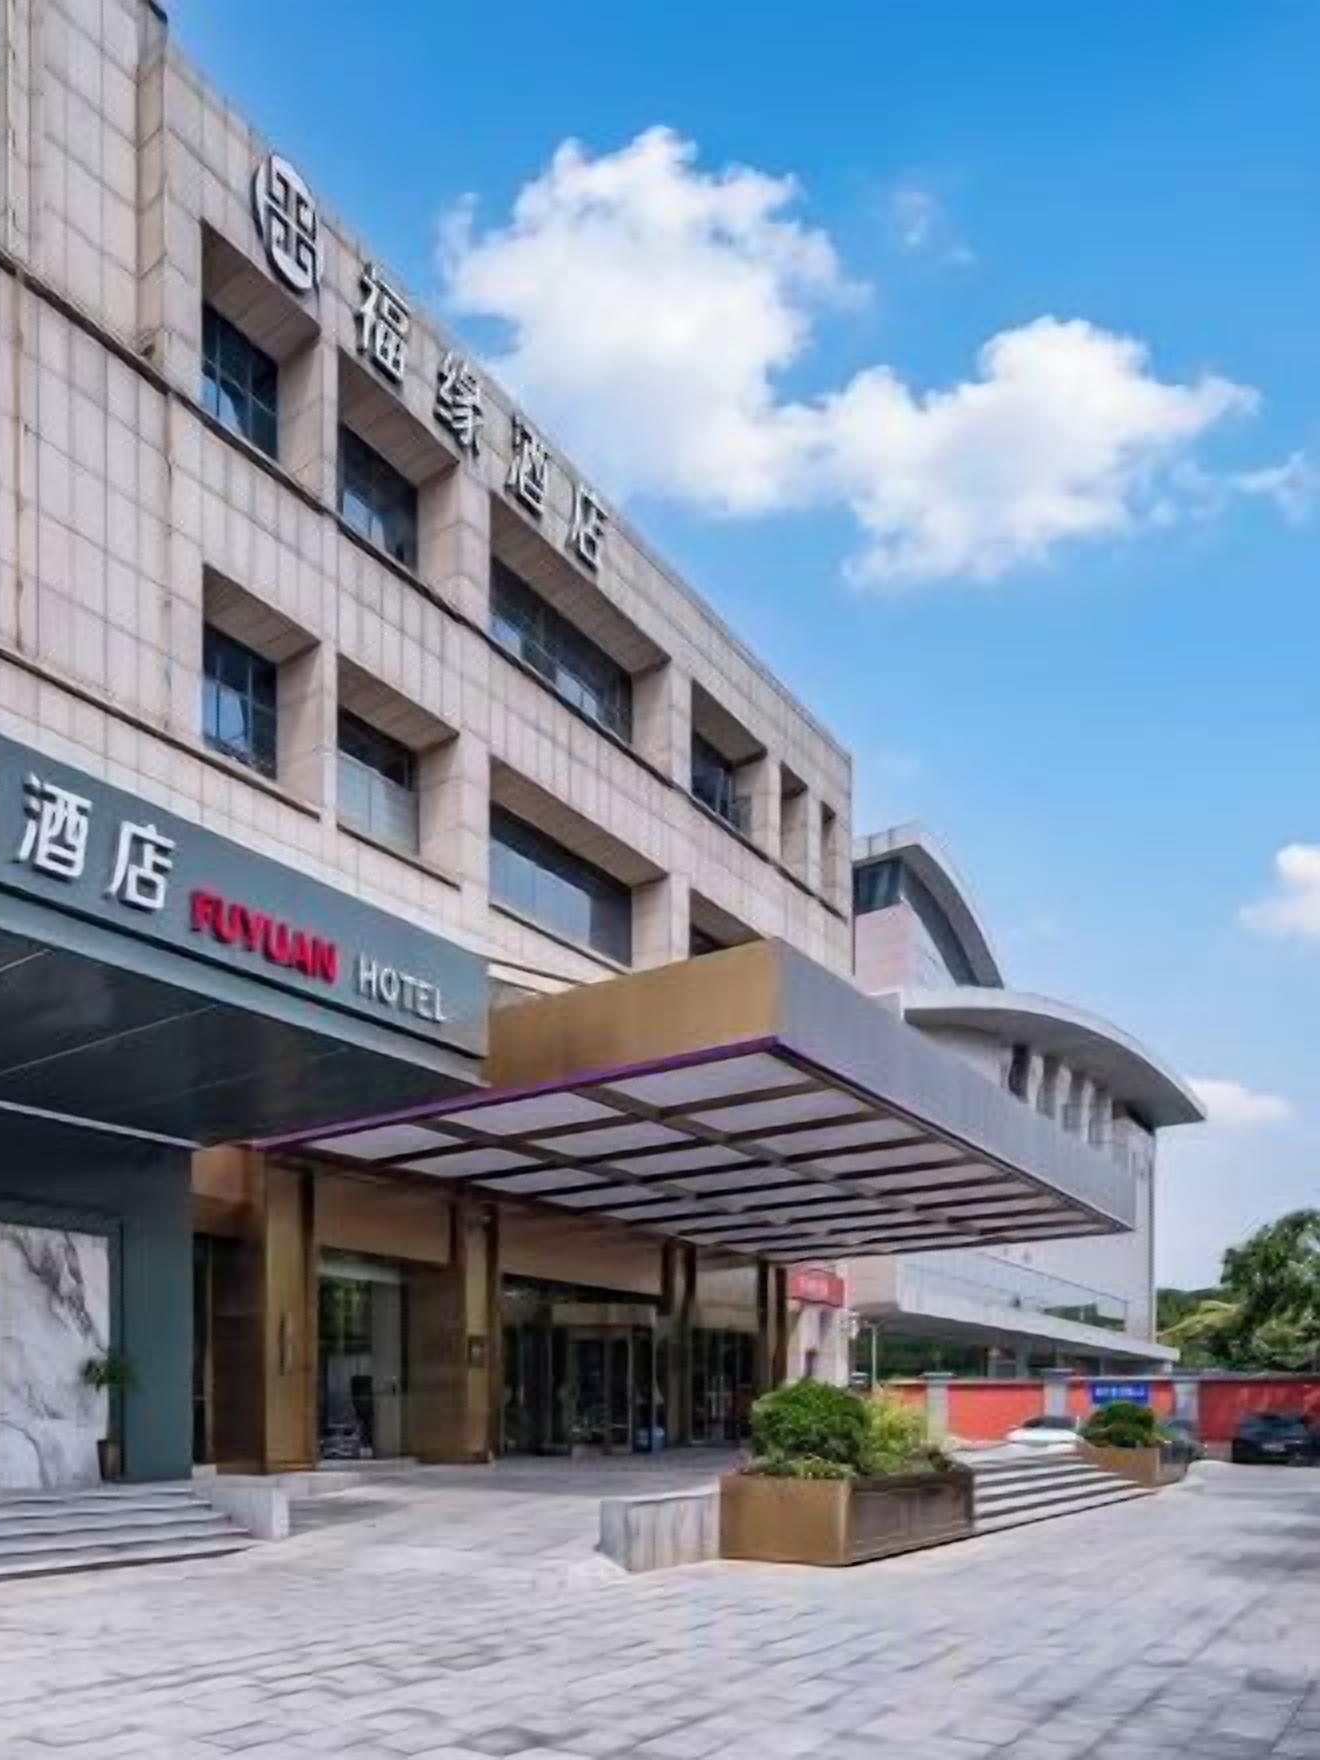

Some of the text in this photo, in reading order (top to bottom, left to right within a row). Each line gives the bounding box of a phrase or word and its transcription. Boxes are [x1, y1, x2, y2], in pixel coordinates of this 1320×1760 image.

[357, 263, 608, 571] 福缘酒店
[189, 889, 338, 984] FUYUAN
[357, 951, 449, 1023] HOTEL
